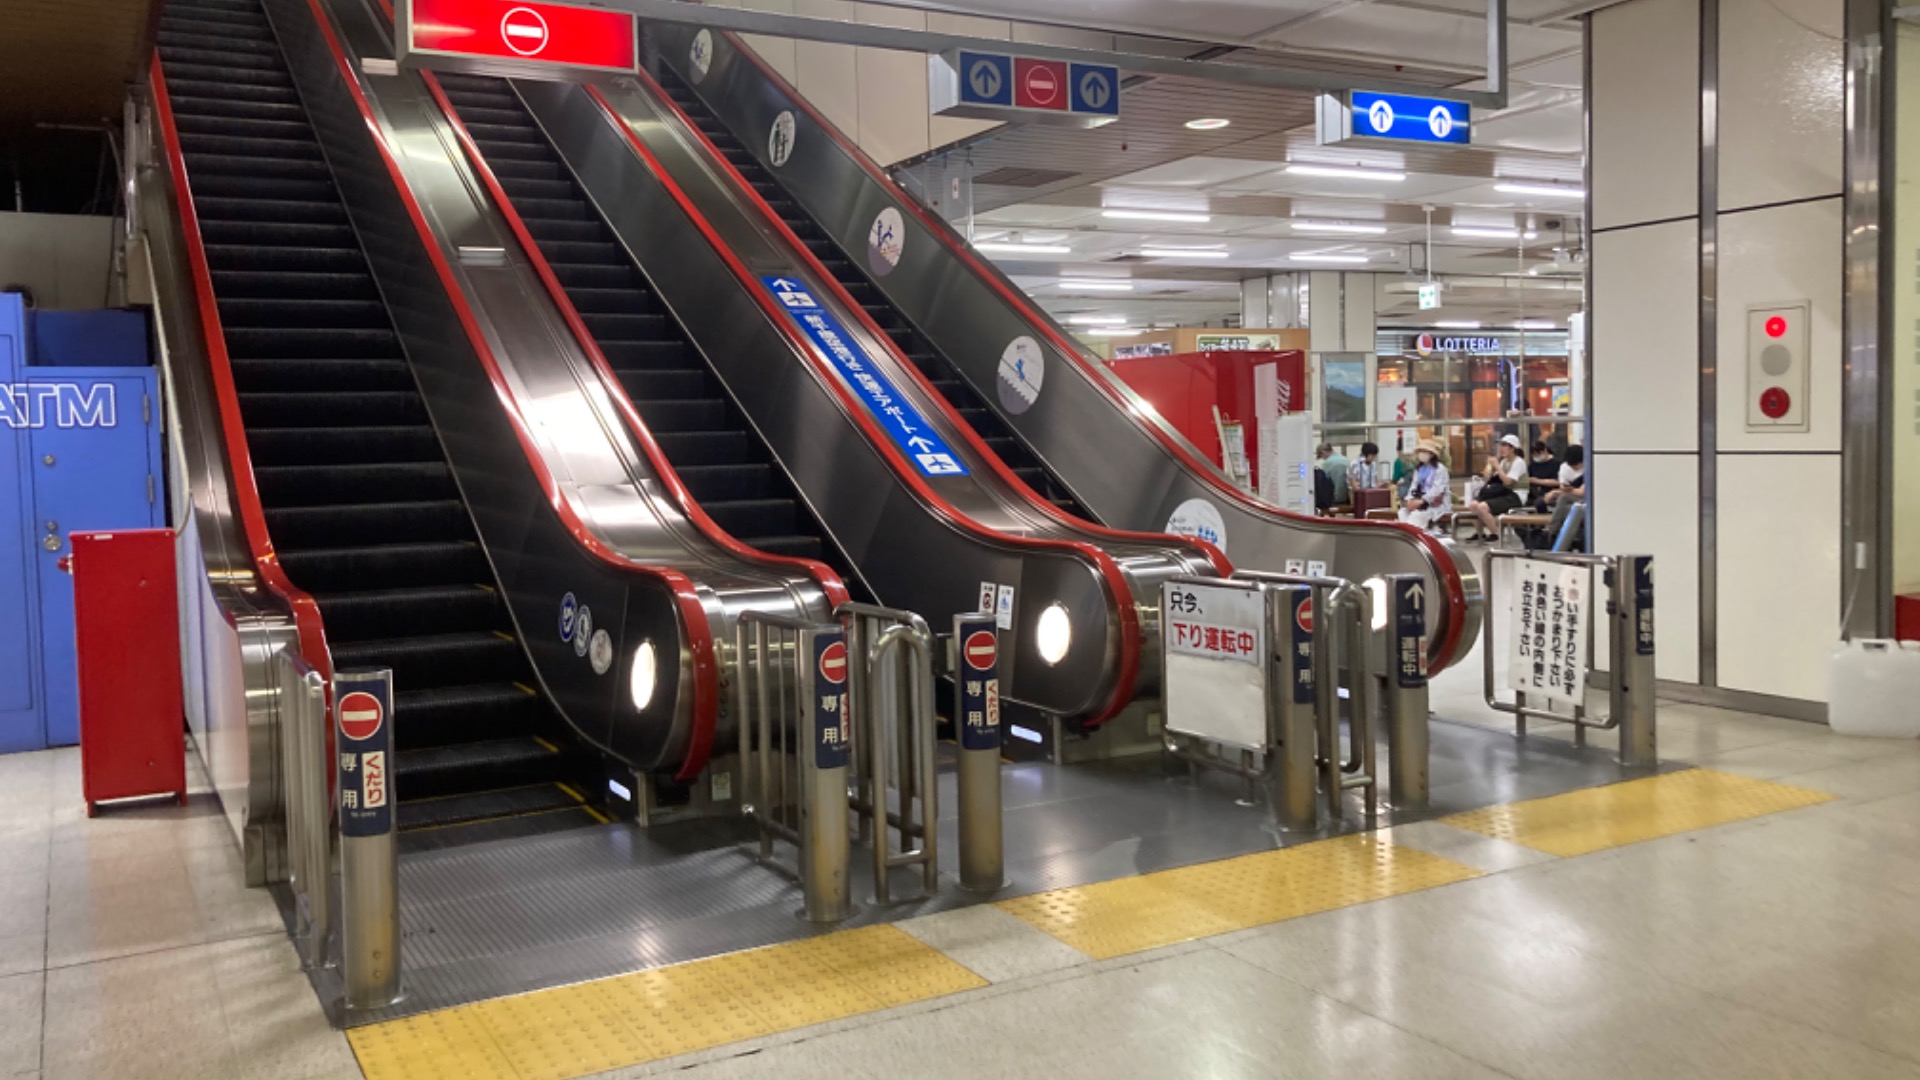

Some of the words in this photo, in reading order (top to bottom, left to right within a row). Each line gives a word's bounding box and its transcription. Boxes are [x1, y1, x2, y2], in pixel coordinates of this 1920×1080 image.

[1435, 337, 1499, 352] LOTTERIA
[1172, 622, 1254, 656] 下り運転中
[1519, 579, 1534, 657] お立ち下さい
[1532, 582, 1548, 688] 黄色い線の内側に
[1550, 585, 1565, 687] おつかまり下さい
[821, 694, 838, 745] 専用
[966, 680, 983, 727] 専用
[987, 681, 998, 724] くだり
[340, 752, 358, 809] 専用
[365, 755, 384, 805] くだり
